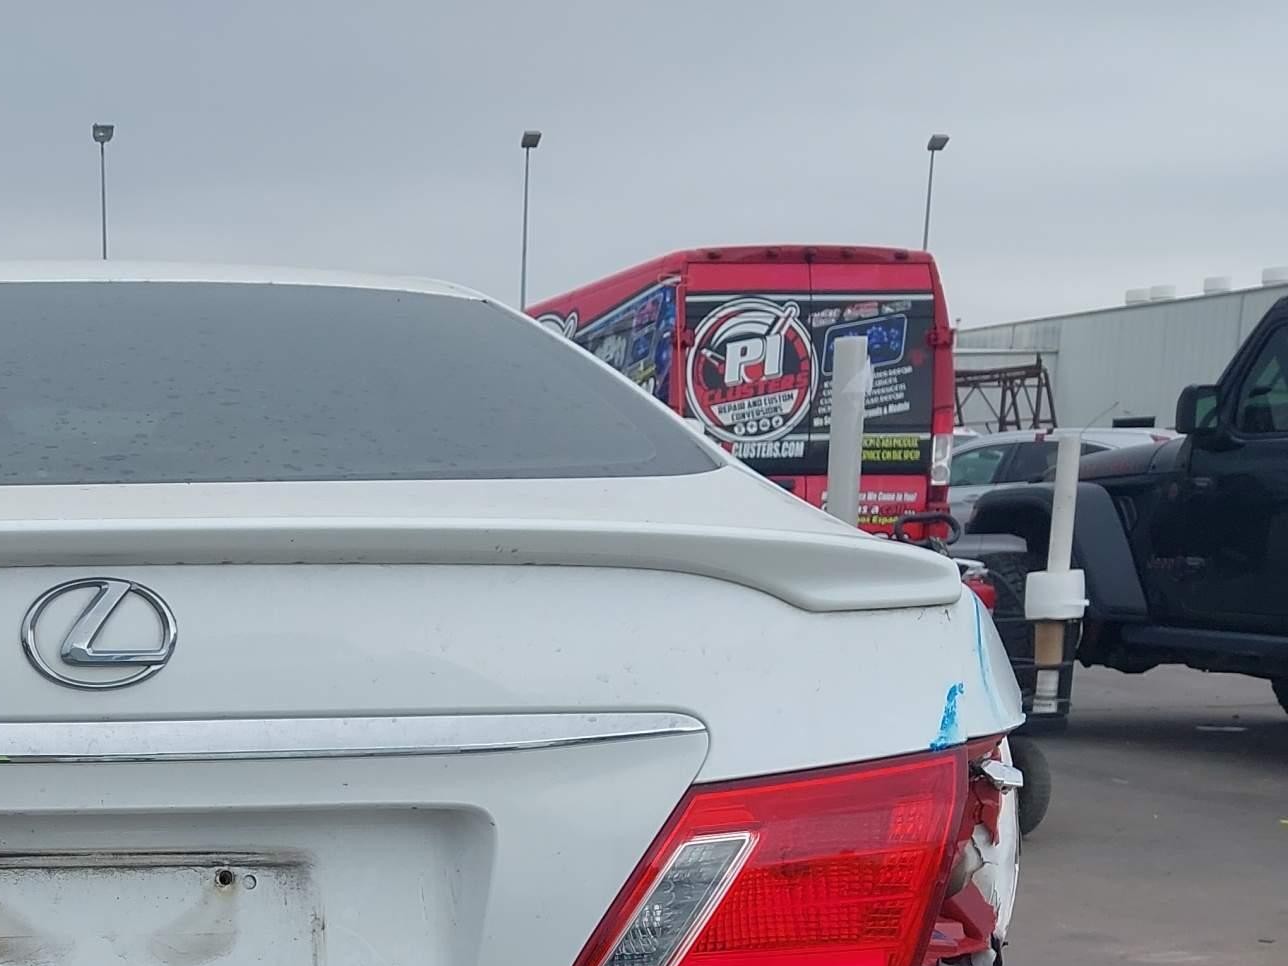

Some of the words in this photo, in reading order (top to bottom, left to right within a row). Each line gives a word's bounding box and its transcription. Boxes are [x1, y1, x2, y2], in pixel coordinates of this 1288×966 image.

[724, 333, 783, 387] PI
[704, 371, 809, 405] CLUSTERS
[717, 402, 745, 414] REPAIR
[747, 398, 762, 409] AND
[764, 392, 794, 406] CUSTOM
[731, 405, 783, 420] CONVERSIONS
